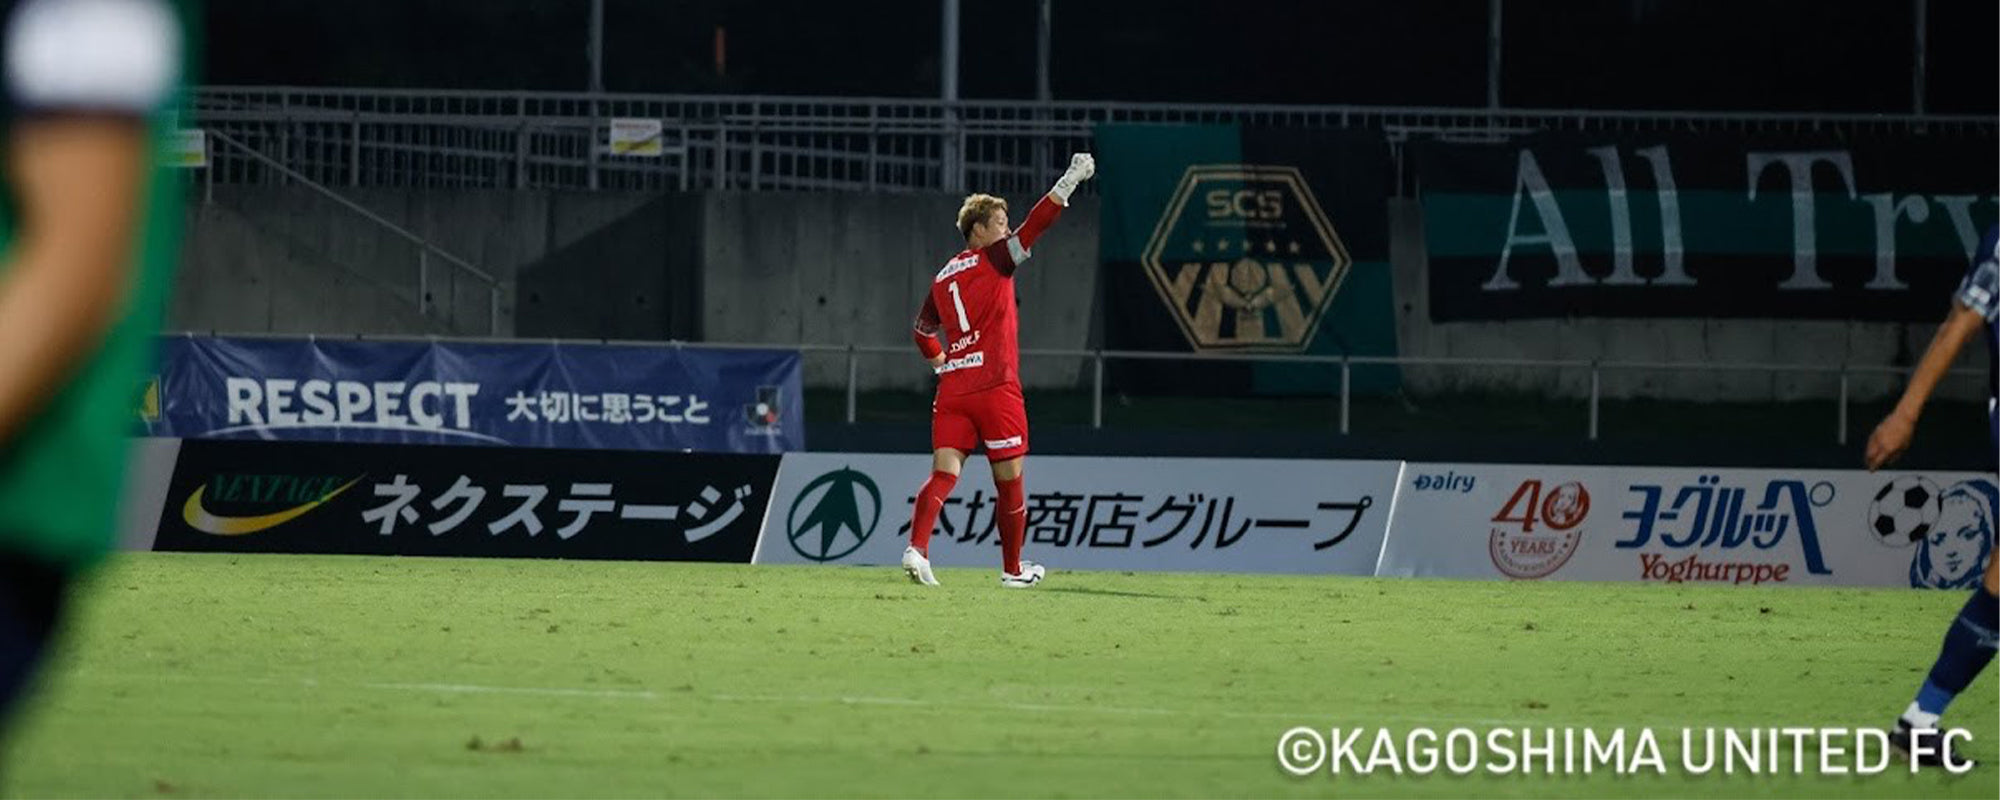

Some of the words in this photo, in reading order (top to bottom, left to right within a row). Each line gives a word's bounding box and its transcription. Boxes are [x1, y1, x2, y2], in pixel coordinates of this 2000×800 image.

[1206, 189, 1284, 219] SCS
[1482, 144, 1698, 290] All
[948, 280, 971, 333] 1
[226, 377, 481, 430] RESPECT
[505, 391, 711, 424] 大切に思うこと
[1412, 470, 1476, 493] Dairy
[361, 473, 752, 544] ネクステージ
[1510, 539, 1556, 554] YEARS
[1639, 553, 1791, 586] Yoghurppe
